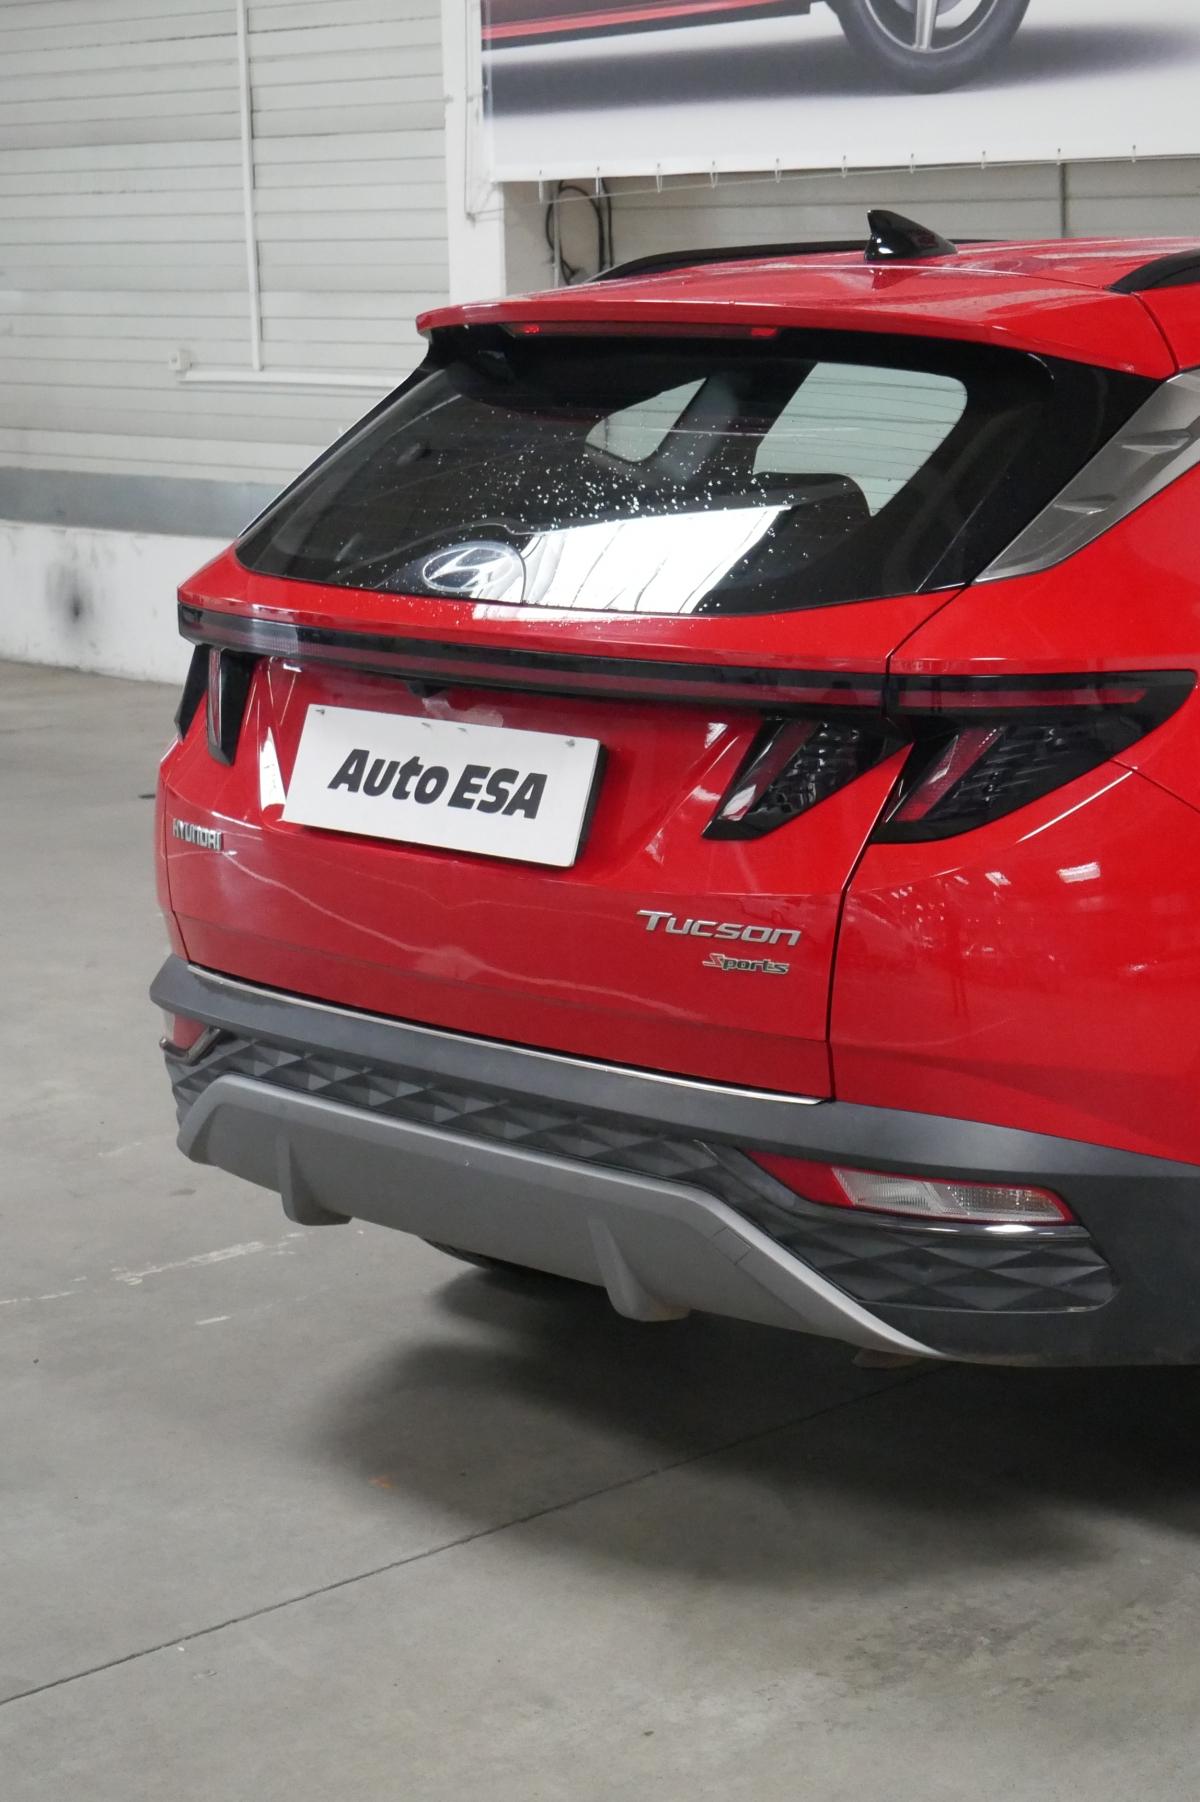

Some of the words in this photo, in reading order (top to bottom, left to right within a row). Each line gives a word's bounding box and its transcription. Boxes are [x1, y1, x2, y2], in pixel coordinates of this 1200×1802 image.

[327, 749, 450, 805] Auto
[447, 764, 548, 819] ESA
[172, 818, 222, 851] HYUNDAI
[702, 953, 790, 975] Sports
